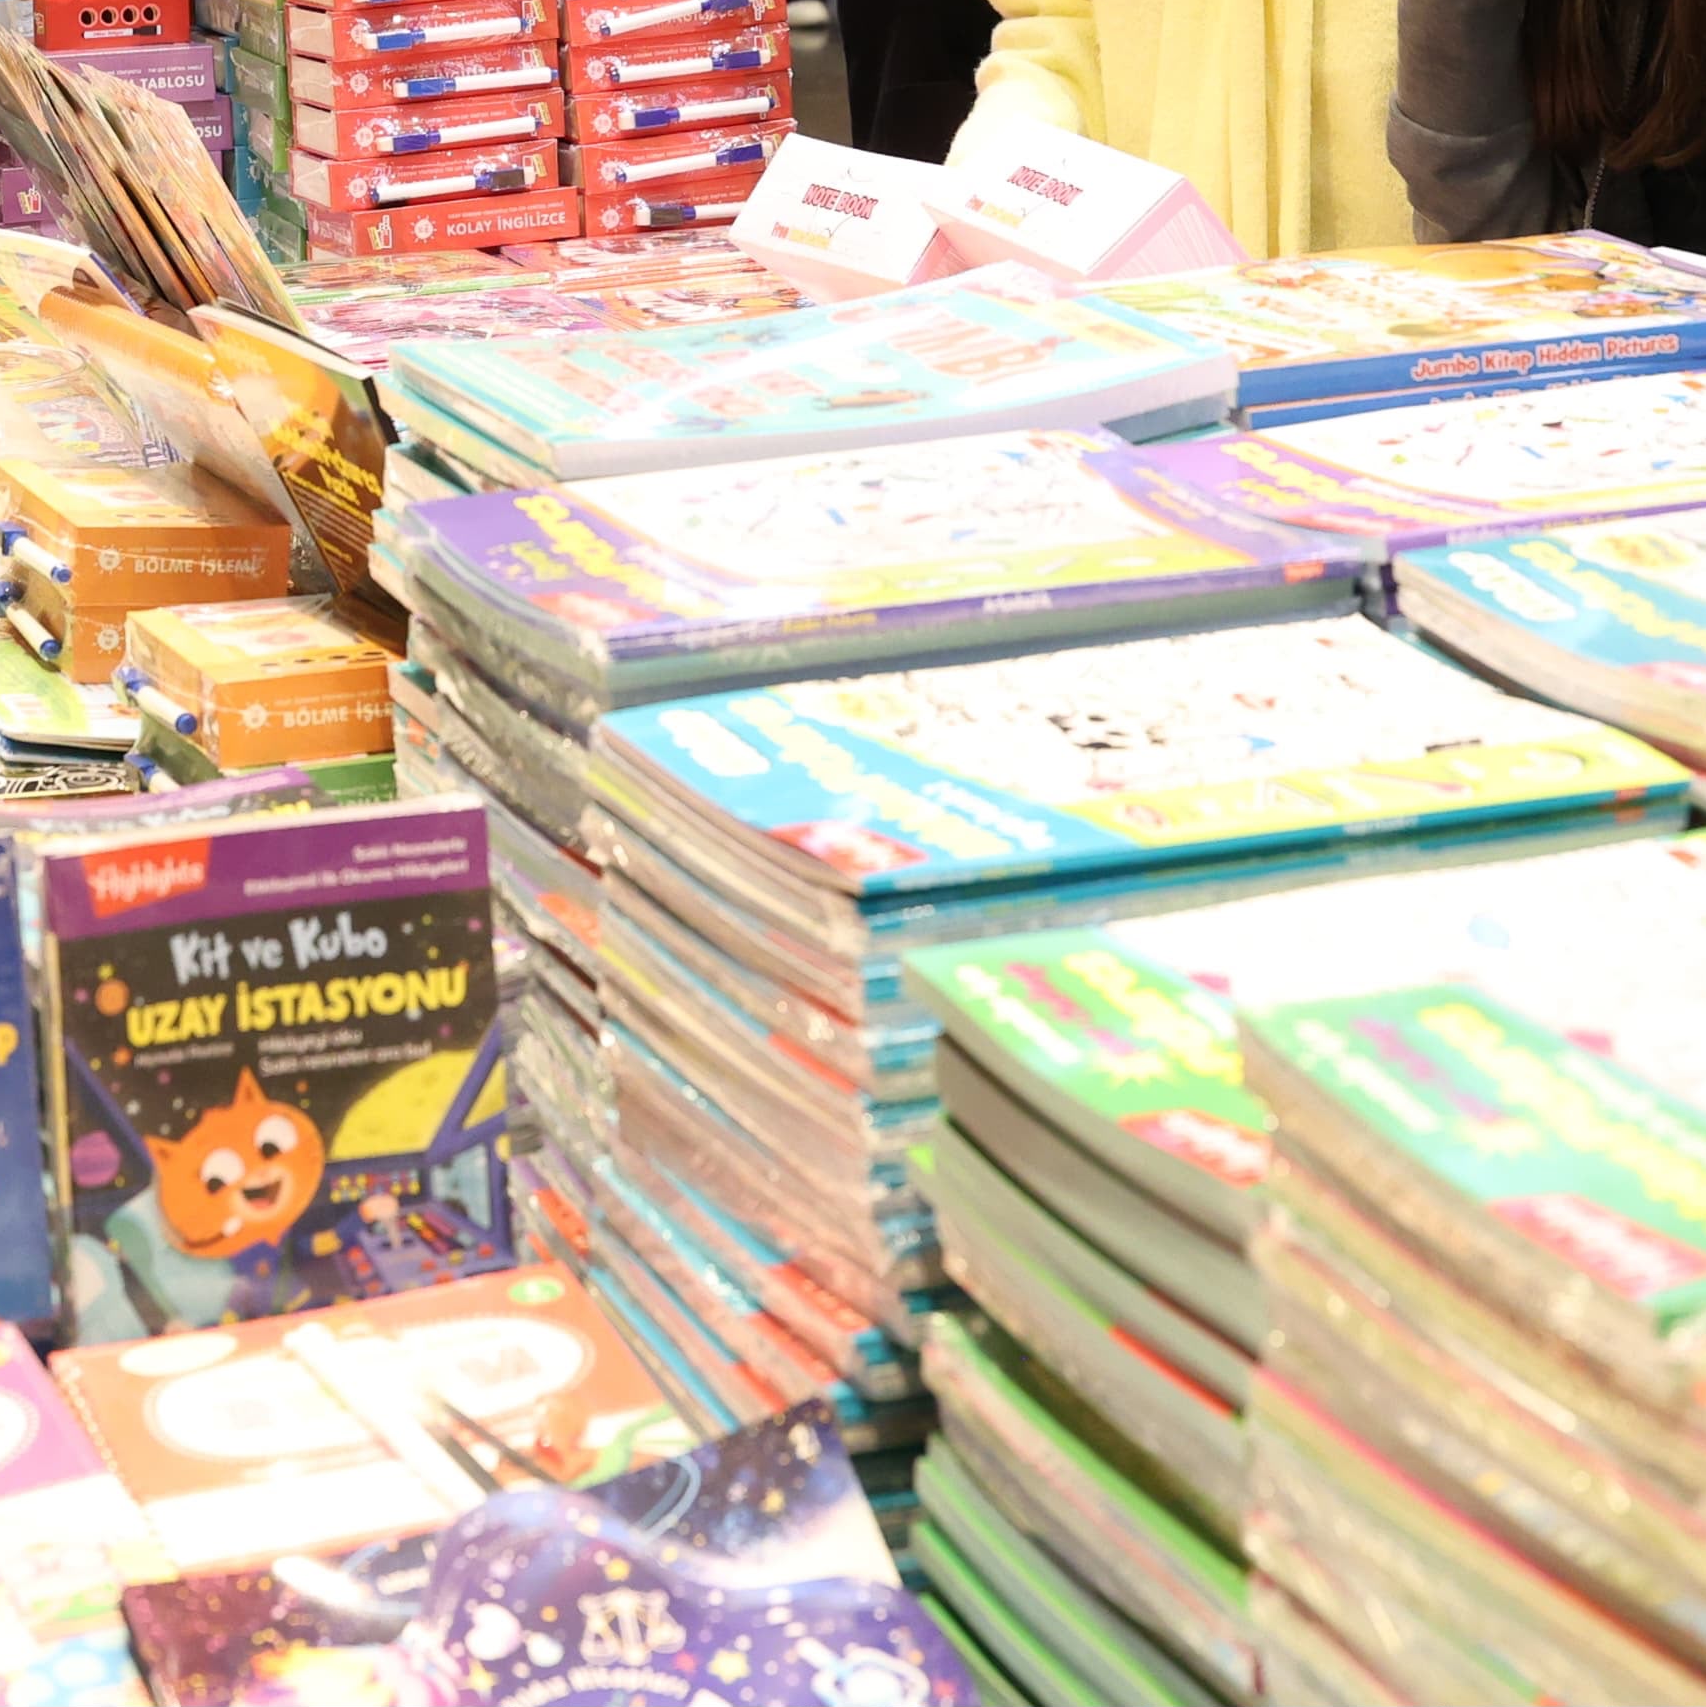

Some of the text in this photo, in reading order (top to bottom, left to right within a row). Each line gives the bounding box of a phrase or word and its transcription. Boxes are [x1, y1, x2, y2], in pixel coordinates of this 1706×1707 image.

[802, 184, 878, 219] NOTE BOOK
[1007, 166, 1083, 206] NOTE BOOK
[446, 210, 566, 237] KOLAY İNGİLİZCE
[1412, 334, 1680, 380] Jumbo Kitap Hidden Pictures
[134, 557, 194, 574] BÖLME
[283, 704, 349, 728] BÖLME
[89, 858, 205, 902] Highlights
[169, 911, 388, 985] Kit ve Kubo
[126, 964, 469, 1048] UZAY İSTASYONU
